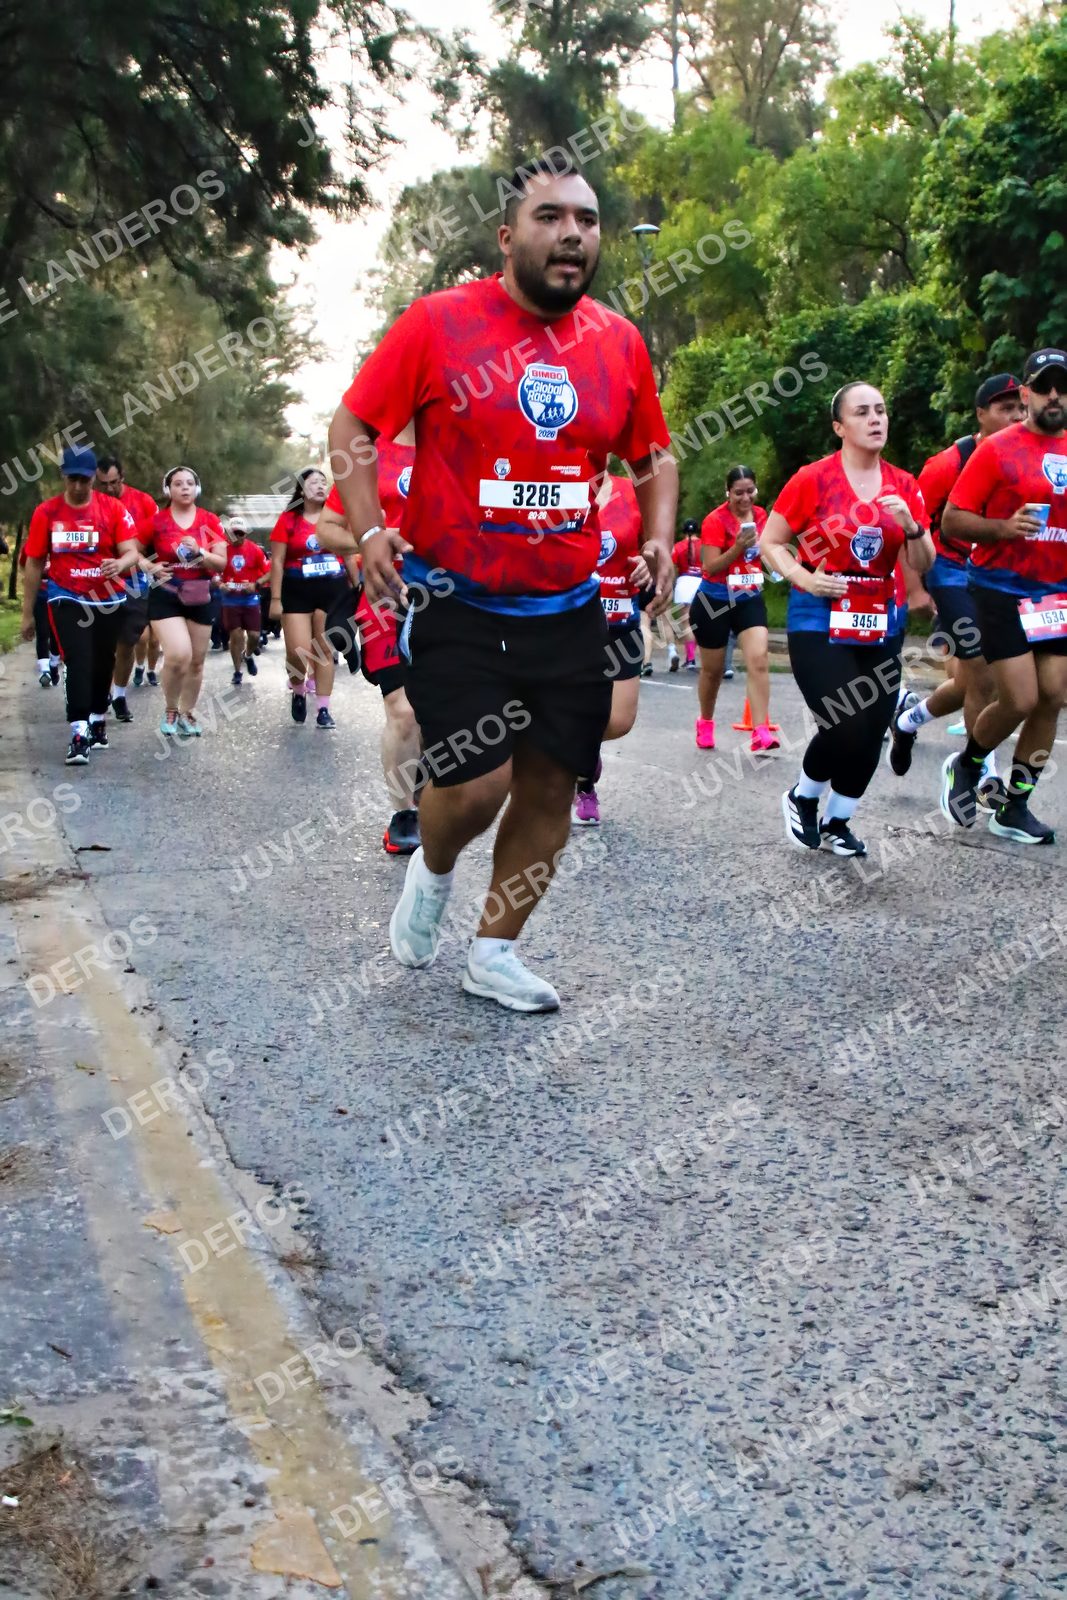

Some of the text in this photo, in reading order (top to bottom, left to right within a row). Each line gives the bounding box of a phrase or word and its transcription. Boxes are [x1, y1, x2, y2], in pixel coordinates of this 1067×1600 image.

[531, 369, 563, 381] BIMBO
[532, 381, 563, 395] Global
[527, 391, 552, 403] Race
[512, 483, 561, 507] 3285
[851, 613, 878, 629] 3454
[1040, 610, 1066, 625] 1534
